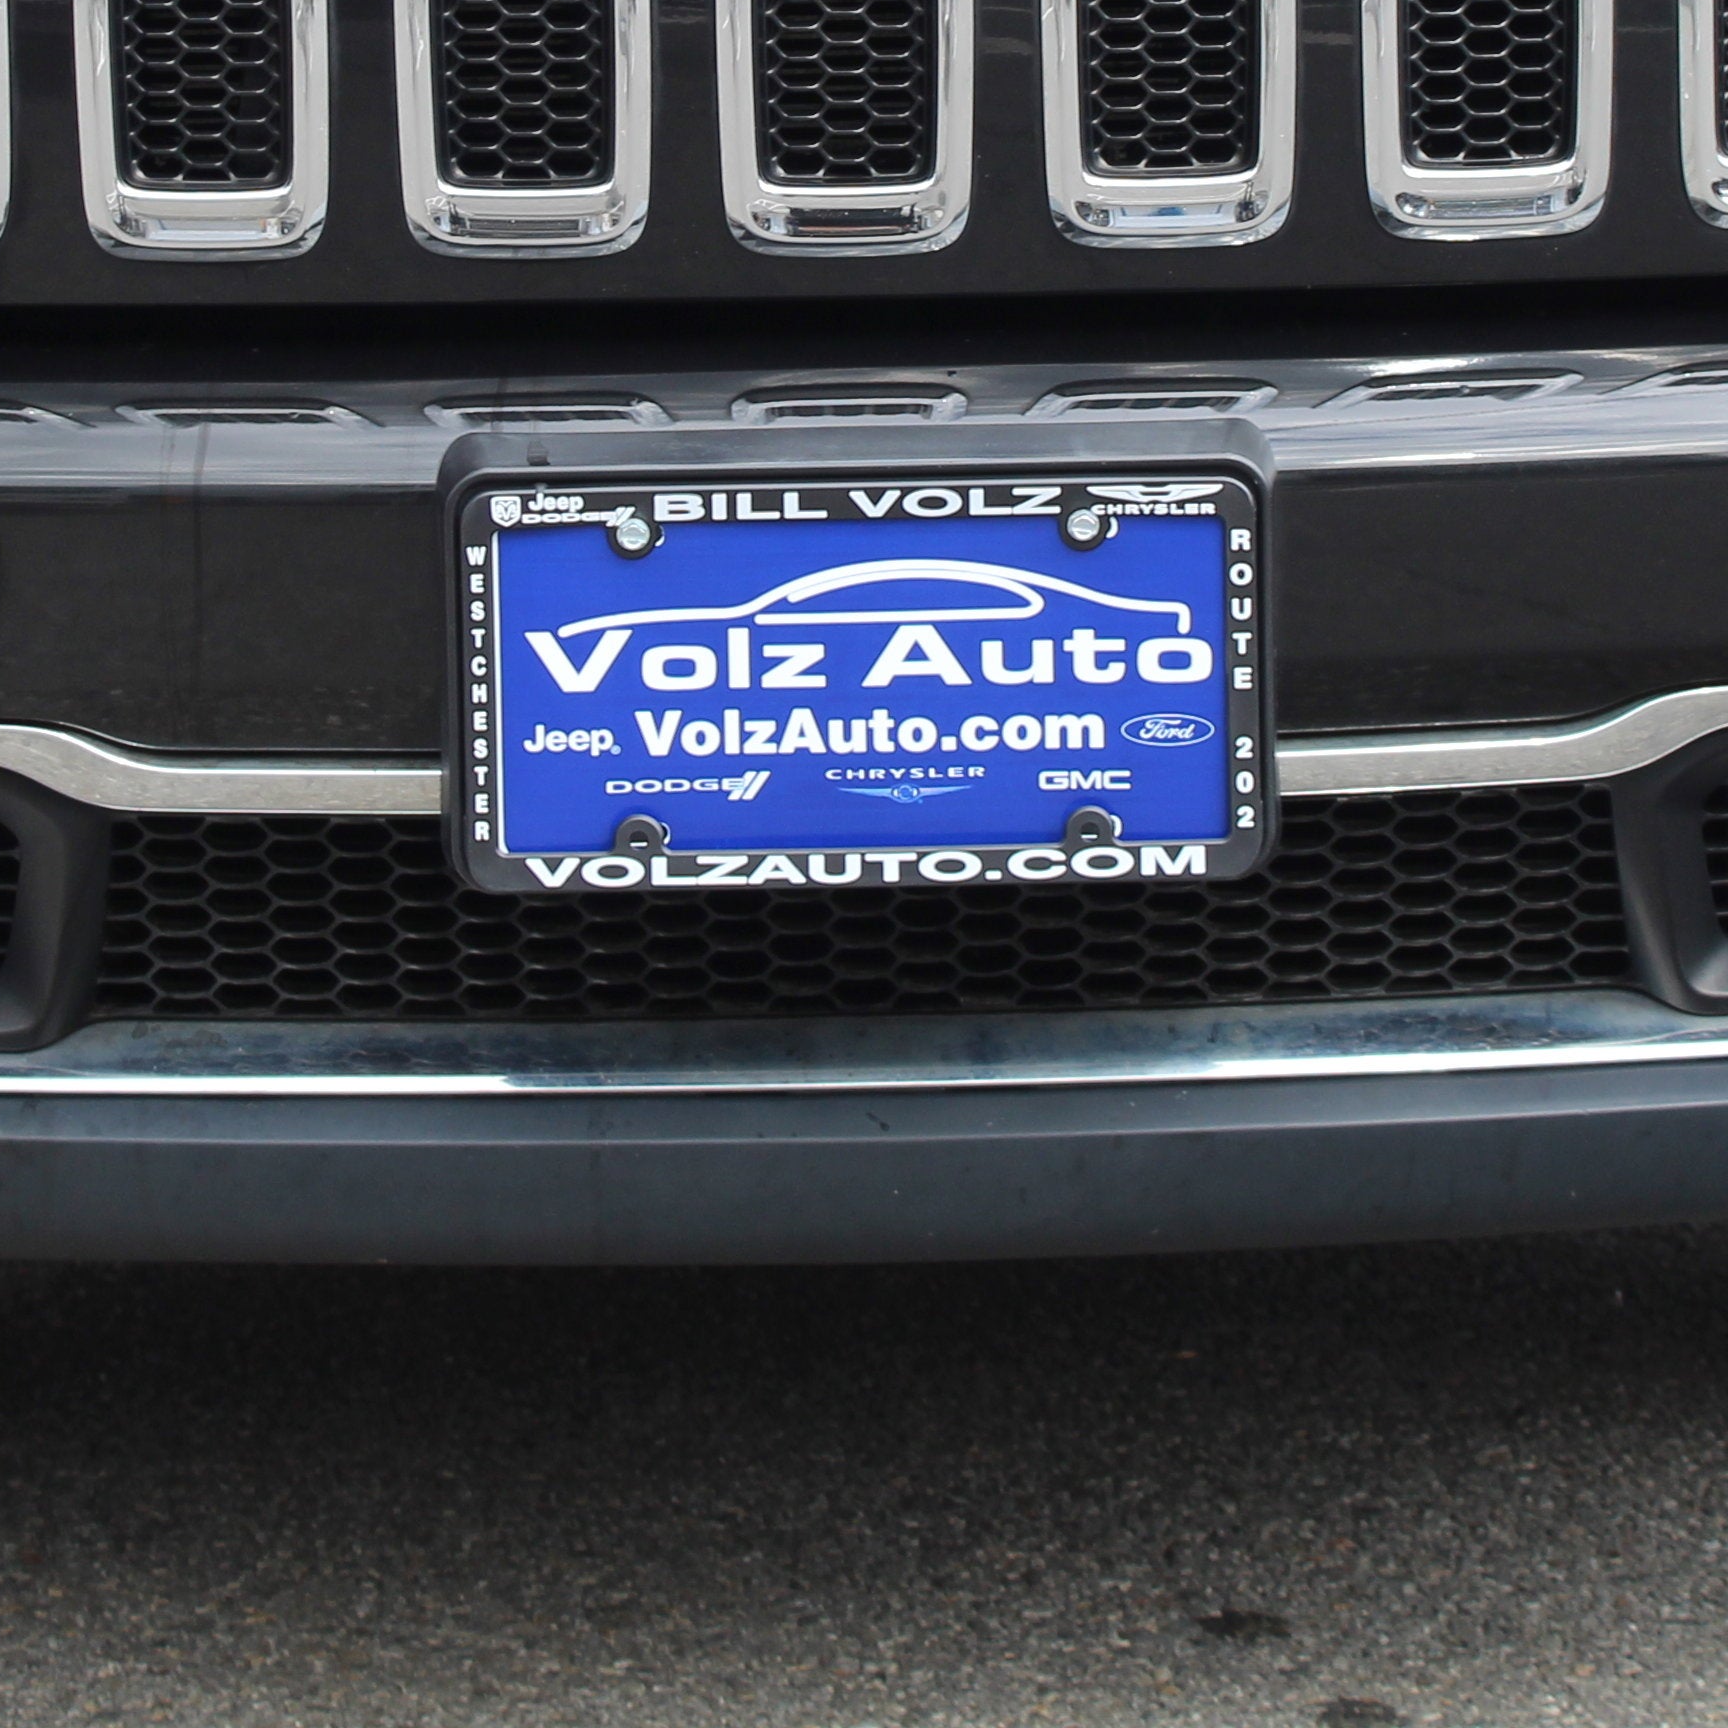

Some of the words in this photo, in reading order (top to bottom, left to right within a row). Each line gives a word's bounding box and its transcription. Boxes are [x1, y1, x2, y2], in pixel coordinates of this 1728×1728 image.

[527, 492, 585, 512] Jeep
[653, 492, 829, 522] BILL
[849, 487, 1062, 518] VOLZ
[1091, 503, 1216, 517] CHRYSLER
[522, 511, 617, 525] DODGE
[1228, 528, 1255, 690] ROUTE
[524, 626, 828, 693] Volz
[861, 623, 1214, 688] Auto
[465, 545, 491, 842] WESTCHESTER
[634, 707, 1105, 757] VolzAuto.com
[1138, 719, 1197, 740] Ford
[605, 776, 745, 795] DODGE
[825, 766, 986, 780] CHRYSLER
[1038, 770, 1132, 791] GMC
[1234, 736, 1256, 828] 202
[525, 845, 1207, 888] VOLZAUTO.COM
